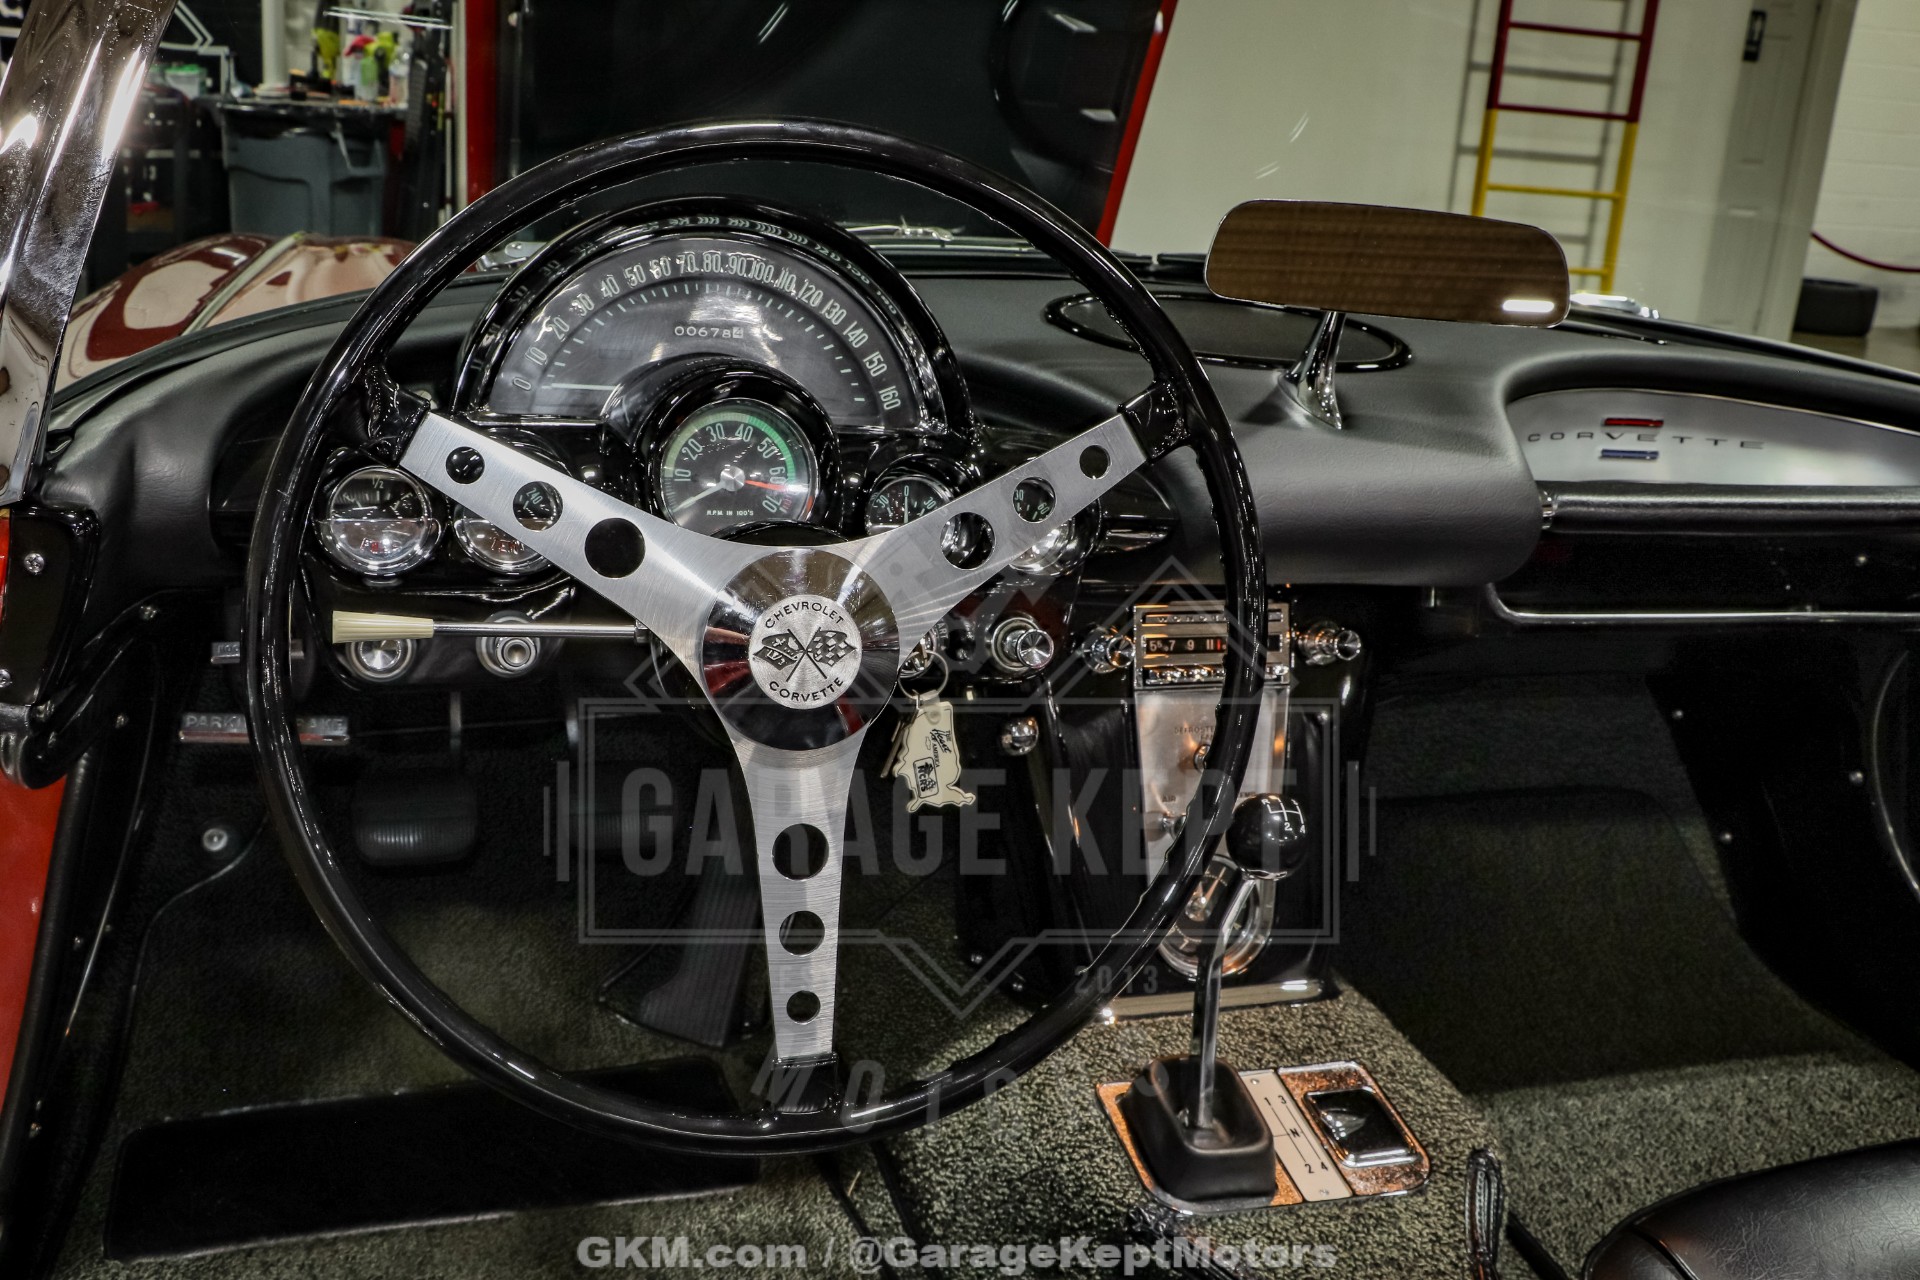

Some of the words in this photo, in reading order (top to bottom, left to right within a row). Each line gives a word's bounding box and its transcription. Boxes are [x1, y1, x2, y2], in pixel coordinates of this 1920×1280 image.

[513, 378, 532, 390] 0
[525, 347, 547, 365] 10
[549, 316, 570, 342] 20
[572, 293, 595, 317] 30
[601, 276, 620, 299] 40
[625, 265, 647, 287] 50
[651, 256, 672, 279] 60
[677, 253, 697, 274] 70
[703, 253, 721, 273] 80
[728, 255, 747, 276] 90
[748, 258, 774, 283] 100
[776, 268, 797, 292] 110
[798, 281, 824, 307] 120
[821, 299, 847, 326] 130
[843, 320, 869, 348] 140
[863, 351, 888, 377] 150
[878, 385, 901, 410] 160
[706, 423, 725, 442] 30
[734, 423, 753, 443] 40
[1527, 431, 1763, 450] CORVETTE
[682, 438, 703, 461] 20
[757, 437, 778, 459] 50
[674, 468, 691, 482] 10
[769, 466, 787, 485] 60
[526, 487, 544, 505] 240
[762, 494, 783, 513] 70
[923, 499, 937, 511] 30
[1037, 502, 1050, 516] 60
[765, 601, 845, 629] CHEVROLET
[769, 677, 844, 702] CORVETTE
[1278, 1095, 1287, 1105] 3
[1305, 1163, 1314, 1174] 2
[1320, 1161, 1329, 1173] 4
